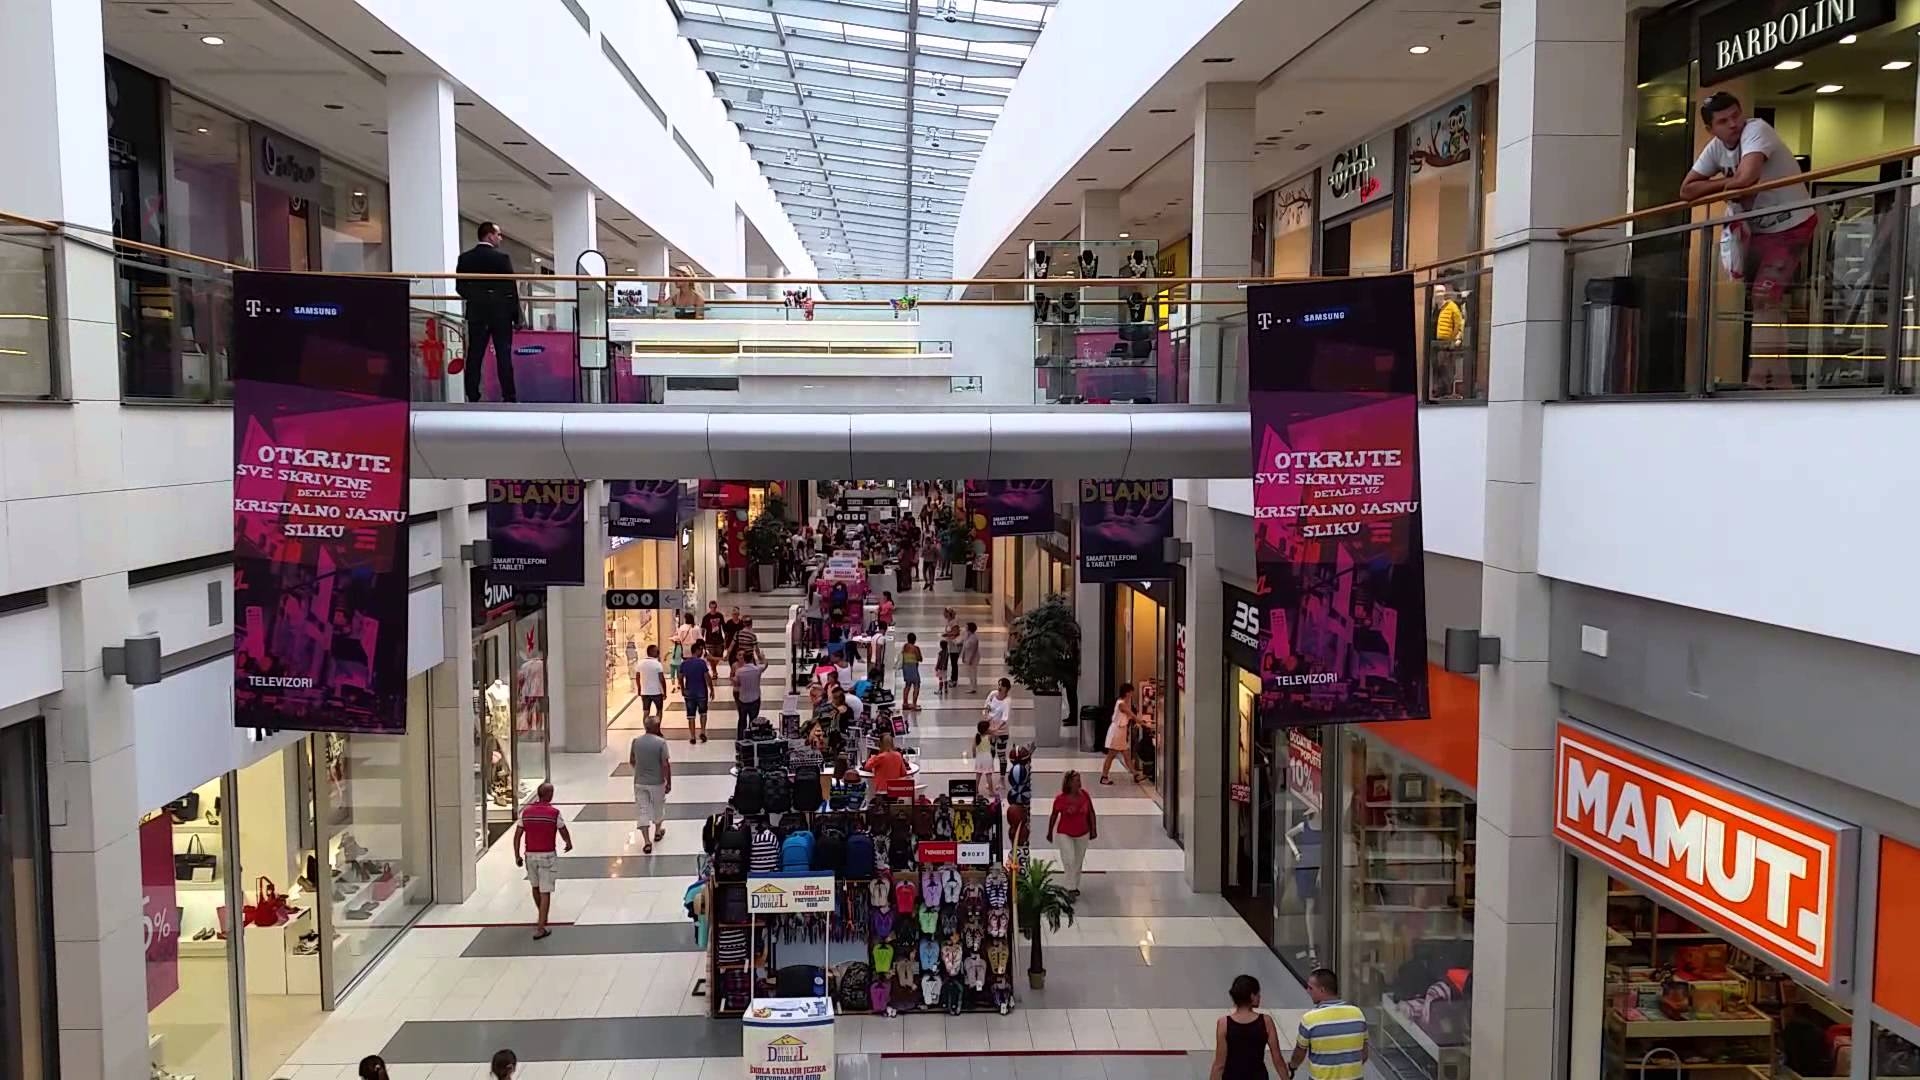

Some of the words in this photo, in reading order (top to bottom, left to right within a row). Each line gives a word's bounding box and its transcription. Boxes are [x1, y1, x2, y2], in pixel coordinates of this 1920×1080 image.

[1716, 0, 1856, 70] BARBOLINI
[294, 306, 337, 315] SAMSUNG
[1304, 312, 1345, 322] SAMSUNG
[258, 446, 391, 473] OTKRIJTE
[1274, 450, 1401, 469] OTKRIJTE
[236, 464, 272, 479] SVE
[278, 469, 372, 491] SKRIVENE
[1255, 473, 1289, 484] SVE
[1295, 473, 1384, 486] SKRIVENE
[297, 489, 347, 499] DETALJE
[350, 491, 367, 499] UZ
[488, 484, 580, 504] DLANU
[1081, 482, 1169, 502] DLANU
[1314, 487, 1362, 498] DETALJE
[1365, 486, 1380, 494] UZ
[235, 499, 341, 518] KRISTALNO
[345, 507, 407, 523] JASNU
[1254, 503, 1356, 519] KRISTALNO
[1361, 502, 1419, 514] JASNU
[284, 523, 345, 538] SLIKU
[1303, 522, 1361, 538] SLIKU
[493, 557, 515, 565] SMART
[1086, 554, 1107, 562] SMART
[248, 675, 313, 688] TELEVIZORI
[1276, 672, 1338, 686] TELEVIZORI
[1289, 756, 1314, 797] 10%
